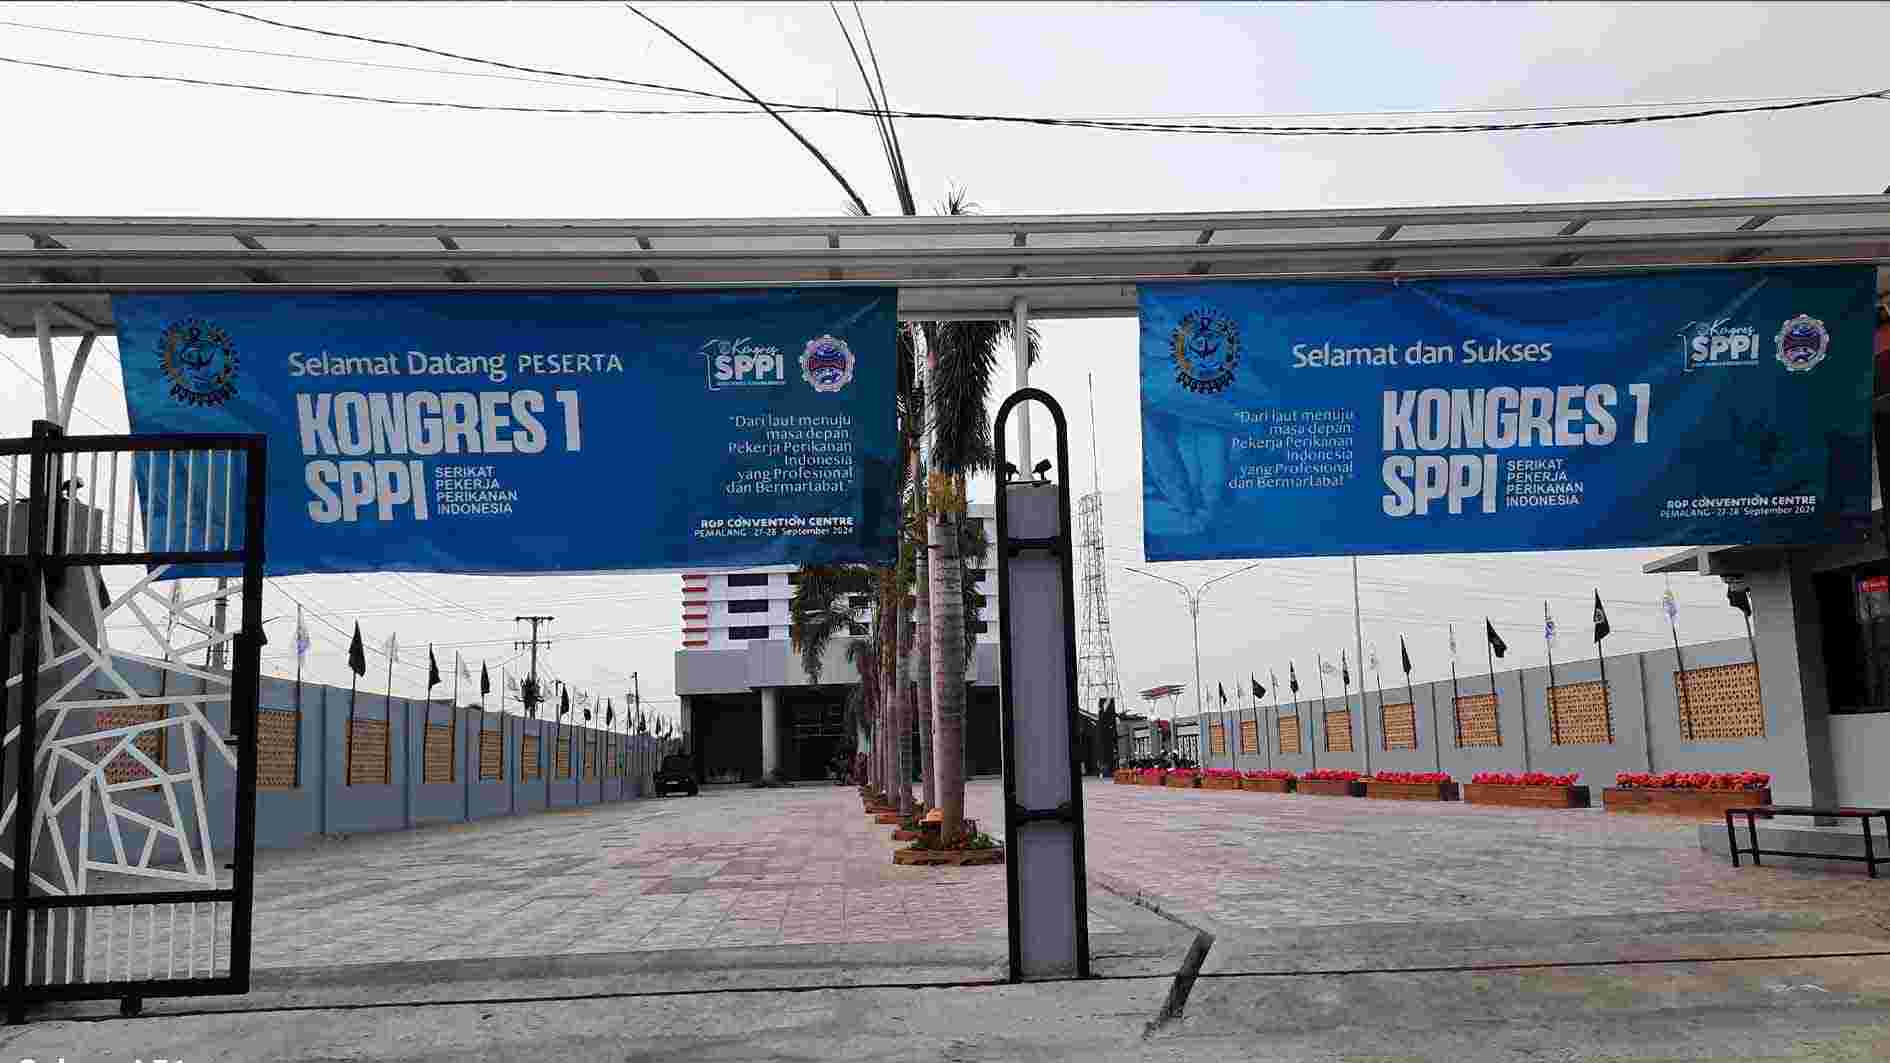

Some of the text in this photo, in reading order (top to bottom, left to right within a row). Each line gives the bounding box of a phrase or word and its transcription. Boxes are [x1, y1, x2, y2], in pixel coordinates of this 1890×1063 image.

[1292, 339, 1552, 368] Selamat dan Sukses
[1691, 334, 1760, 362] SPPI
[288, 350, 624, 382] Selamat Datang PESERTA
[714, 353, 784, 381] SPPI
[767, 414, 796, 426] laut
[799, 413, 852, 430] menuju
[1301, 407, 1353, 424] menuju
[1383, 383, 1650, 450] KONGRES 1
[297, 389, 546, 456] KONGRES
[556, 389, 582, 453] 1
[766, 429, 803, 440] masa
[728, 440, 852, 456] Pekerja Perikanan
[1232, 434, 1353, 450] Pekerja Perikanan
[784, 454, 853, 466] Indonesia
[1287, 448, 1353, 461] Indonesia
[1240, 460, 1353, 479] yang Profesional
[1506, 458, 1564, 472] SERIKAT
[434, 466, 496, 478] SERIKAT
[736, 467, 853, 482] yang Profesional
[1507, 471, 1568, 483] PEKERJA
[435, 479, 500, 491] PEKERJA
[726, 480, 751, 493] dan
[1226, 475, 1255, 488] dan
[1382, 454, 1498, 517] SPPI
[305, 460, 428, 523] SPPI
[1506, 482, 1584, 495] PERIKANAN
[436, 489, 518, 502] PERIKANAN
[1506, 495, 1579, 508] INDONESIA
[1691, 496, 1769, 508] CONVENTION
[1771, 495, 1817, 505] CENTRE
[437, 502, 513, 515] INDONESIA
[1743, 505, 1792, 517] September
[1794, 504, 1816, 514] 2024
[727, 517, 806, 528] CONVENTION
[808, 516, 854, 527] CENTRE
[782, 527, 830, 538] September
